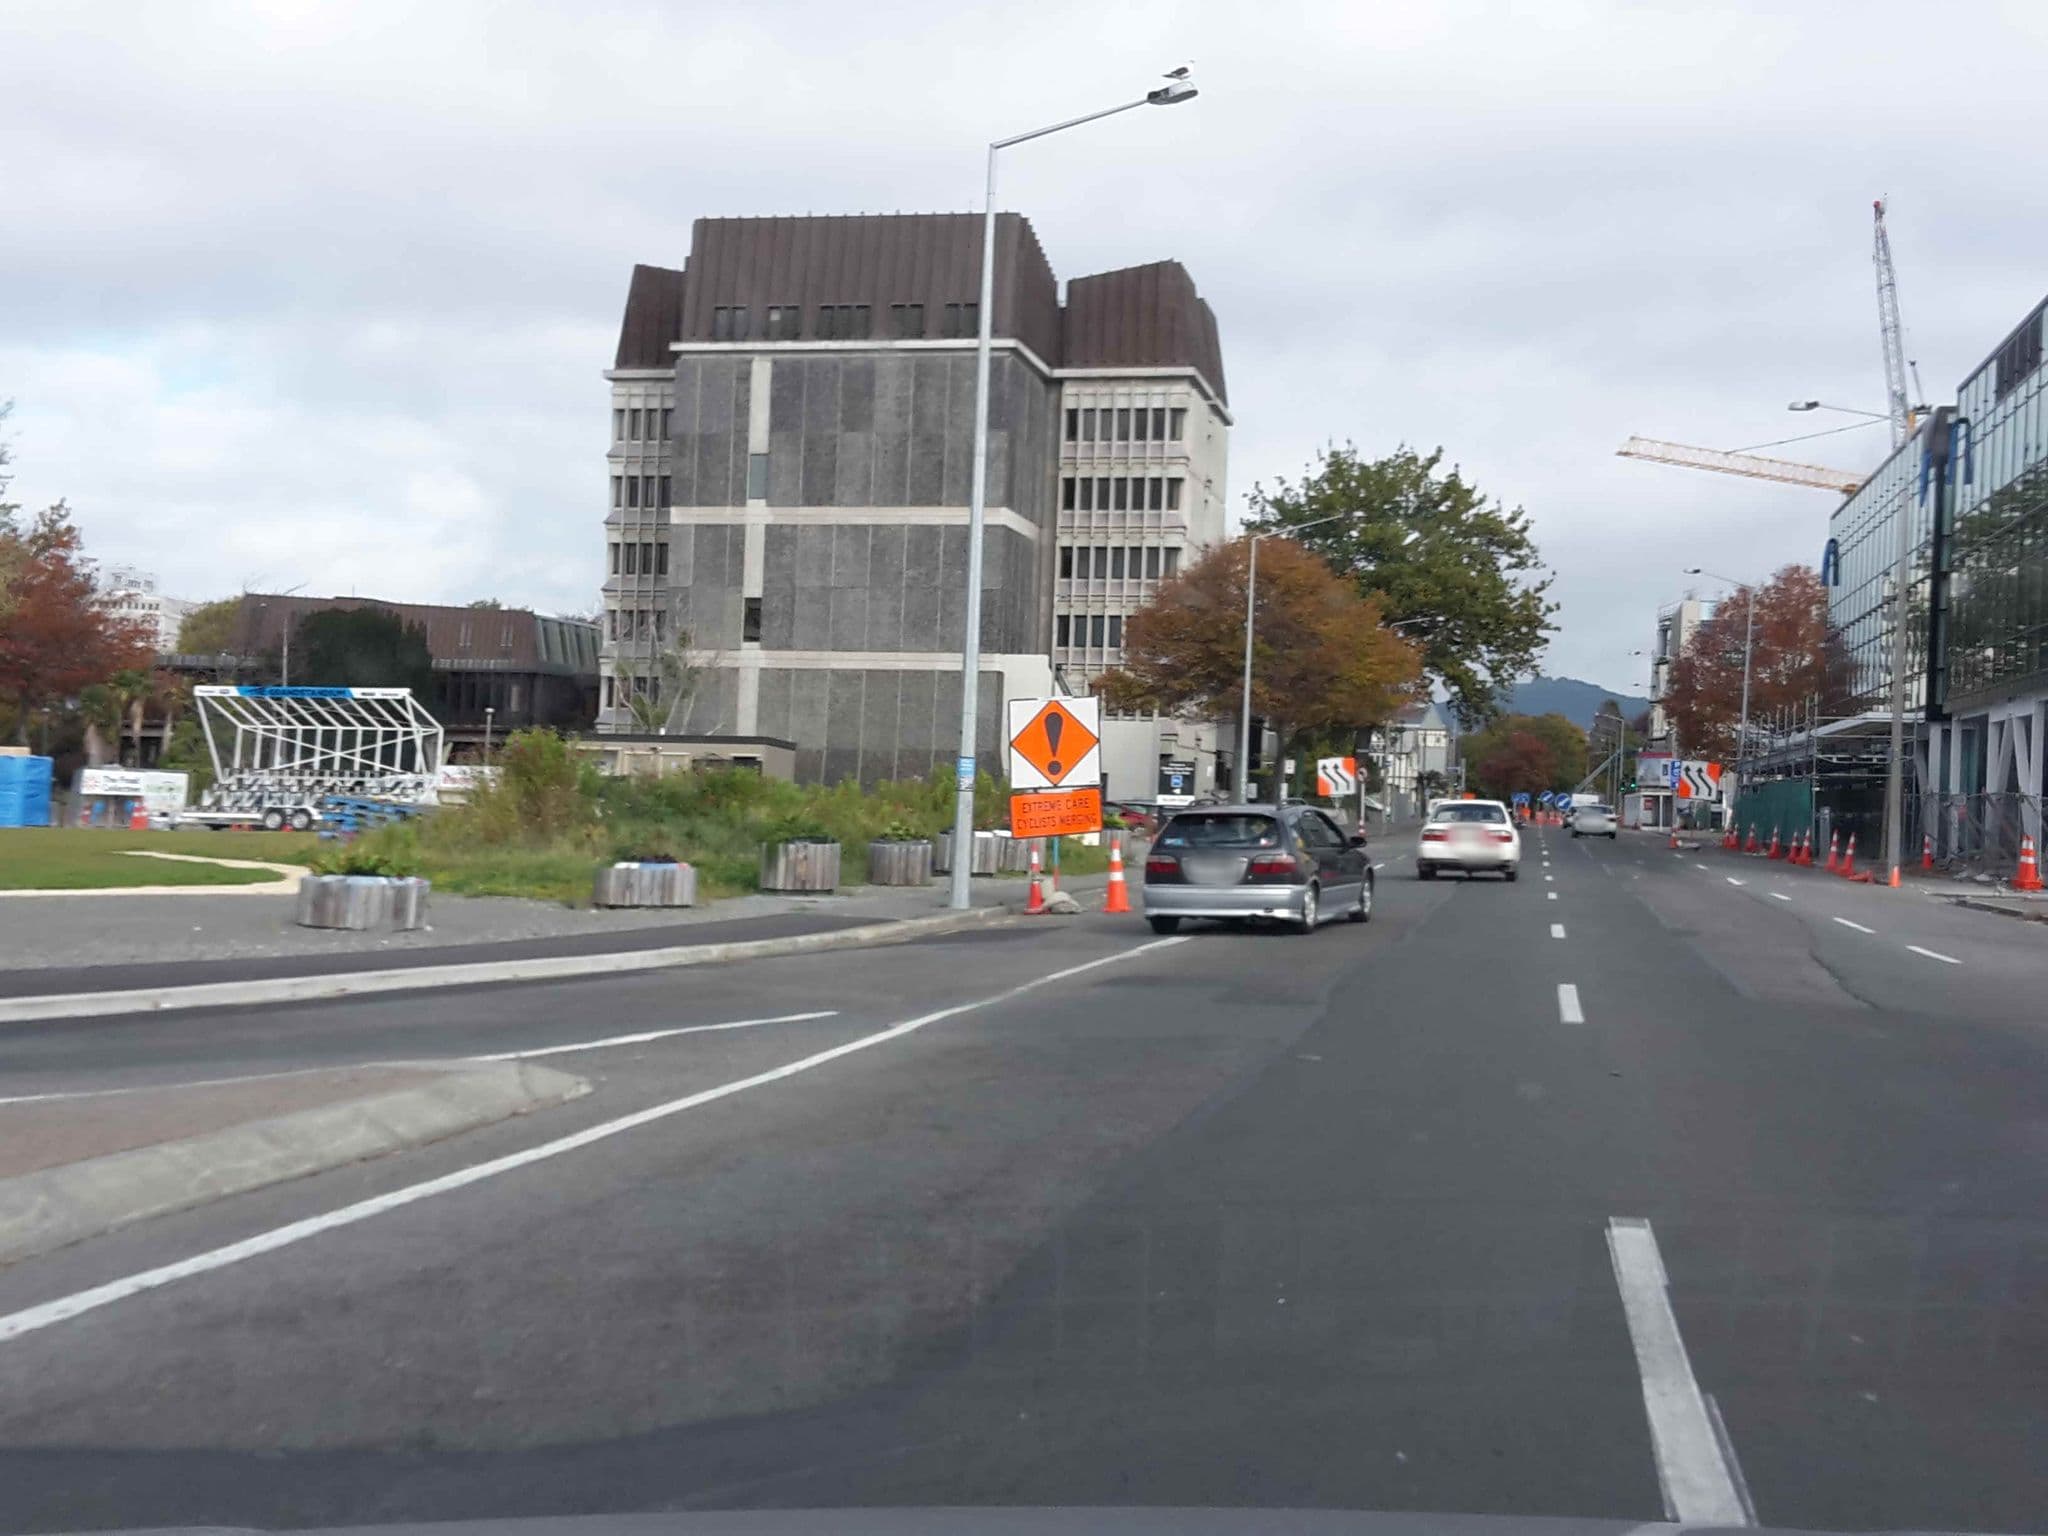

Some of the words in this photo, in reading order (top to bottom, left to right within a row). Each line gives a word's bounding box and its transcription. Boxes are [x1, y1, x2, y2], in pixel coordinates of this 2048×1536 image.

[1022, 799, 1063, 814] EXTREME
[1065, 797, 1089, 810] CARE
[1017, 816, 1056, 830] CYCLISTS
